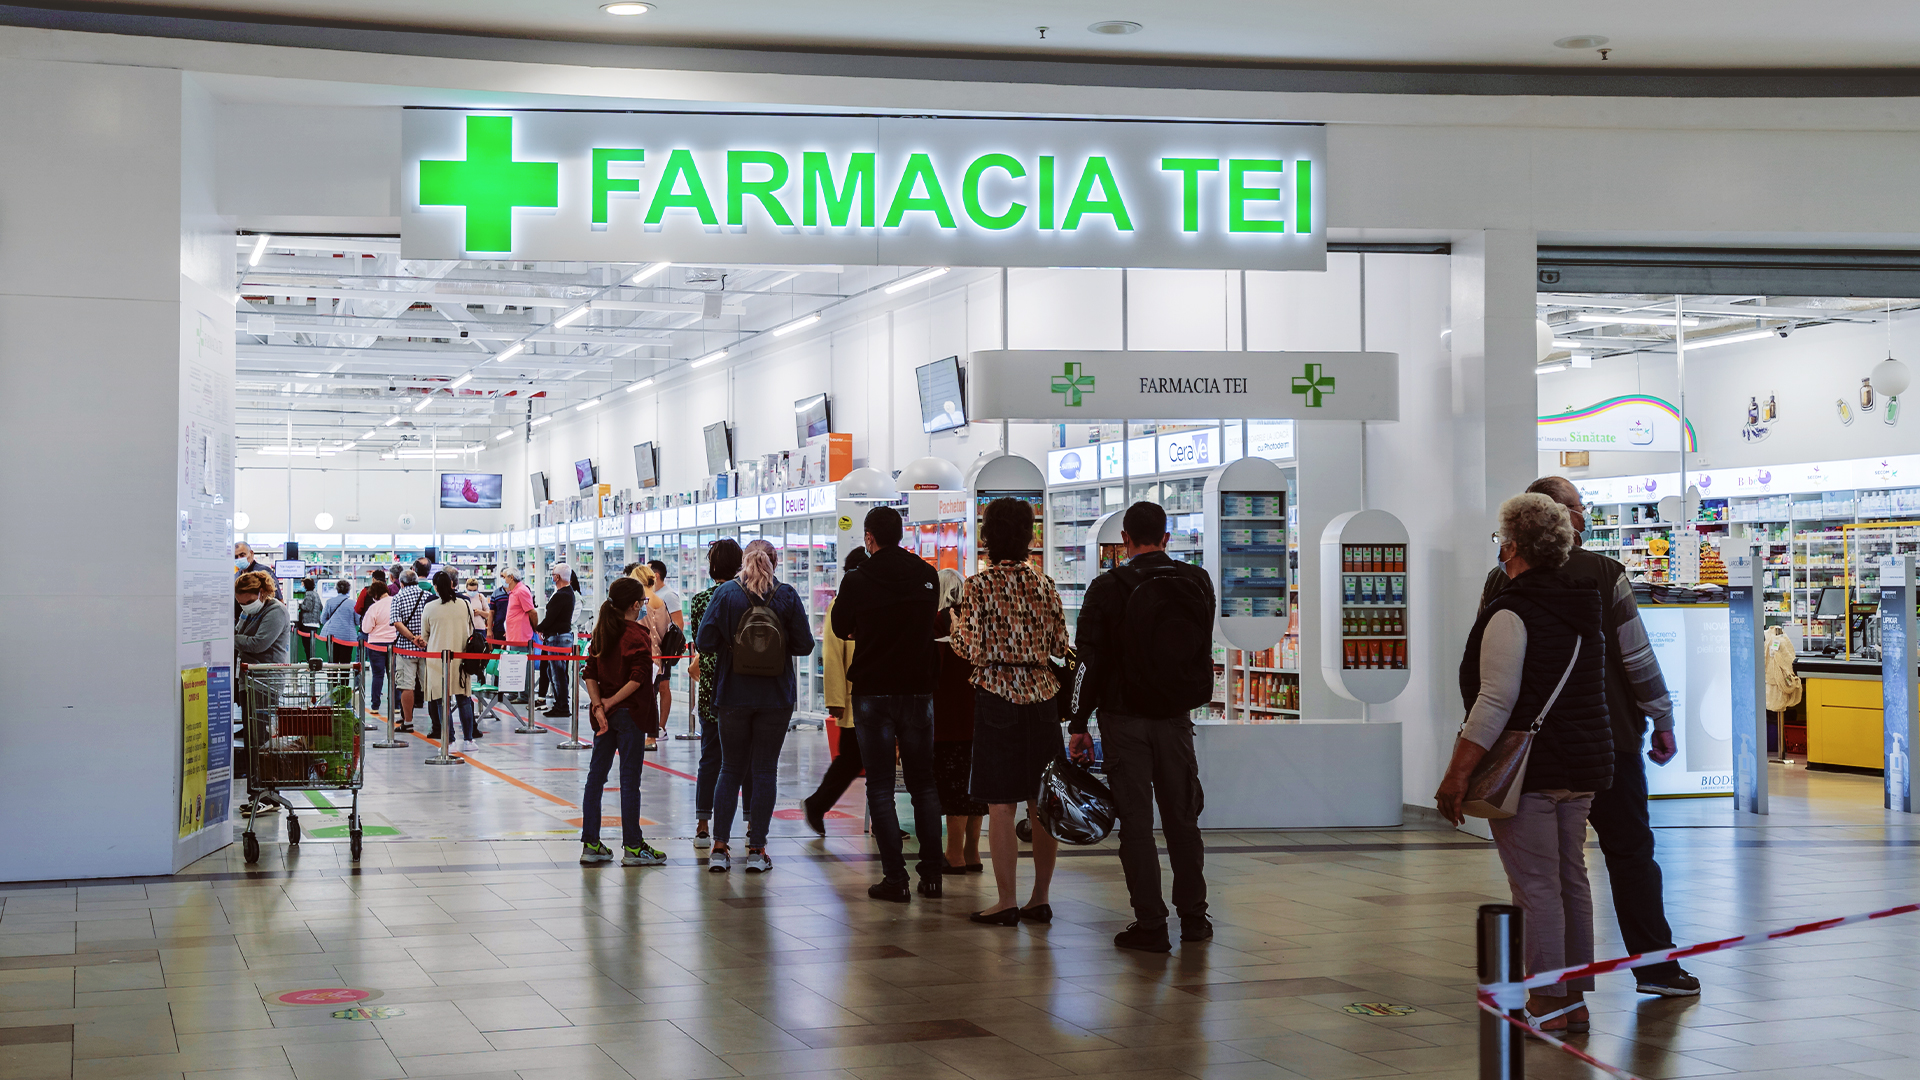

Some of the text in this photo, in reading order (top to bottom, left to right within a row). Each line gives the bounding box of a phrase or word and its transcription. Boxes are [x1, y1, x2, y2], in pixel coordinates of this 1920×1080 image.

[592, 147, 1312, 234] FARMACIA TEI
[1139, 377, 1248, 394] FARMACIA TEI
[1569, 431, 1617, 443] Sănătate
[1169, 436, 1208, 462] CeraVe
[785, 495, 807, 513] beurer
[402, 517, 411, 525] 16
[1703, 622, 1730, 631] INOVA
[1701, 775, 1735, 786] BIODE
